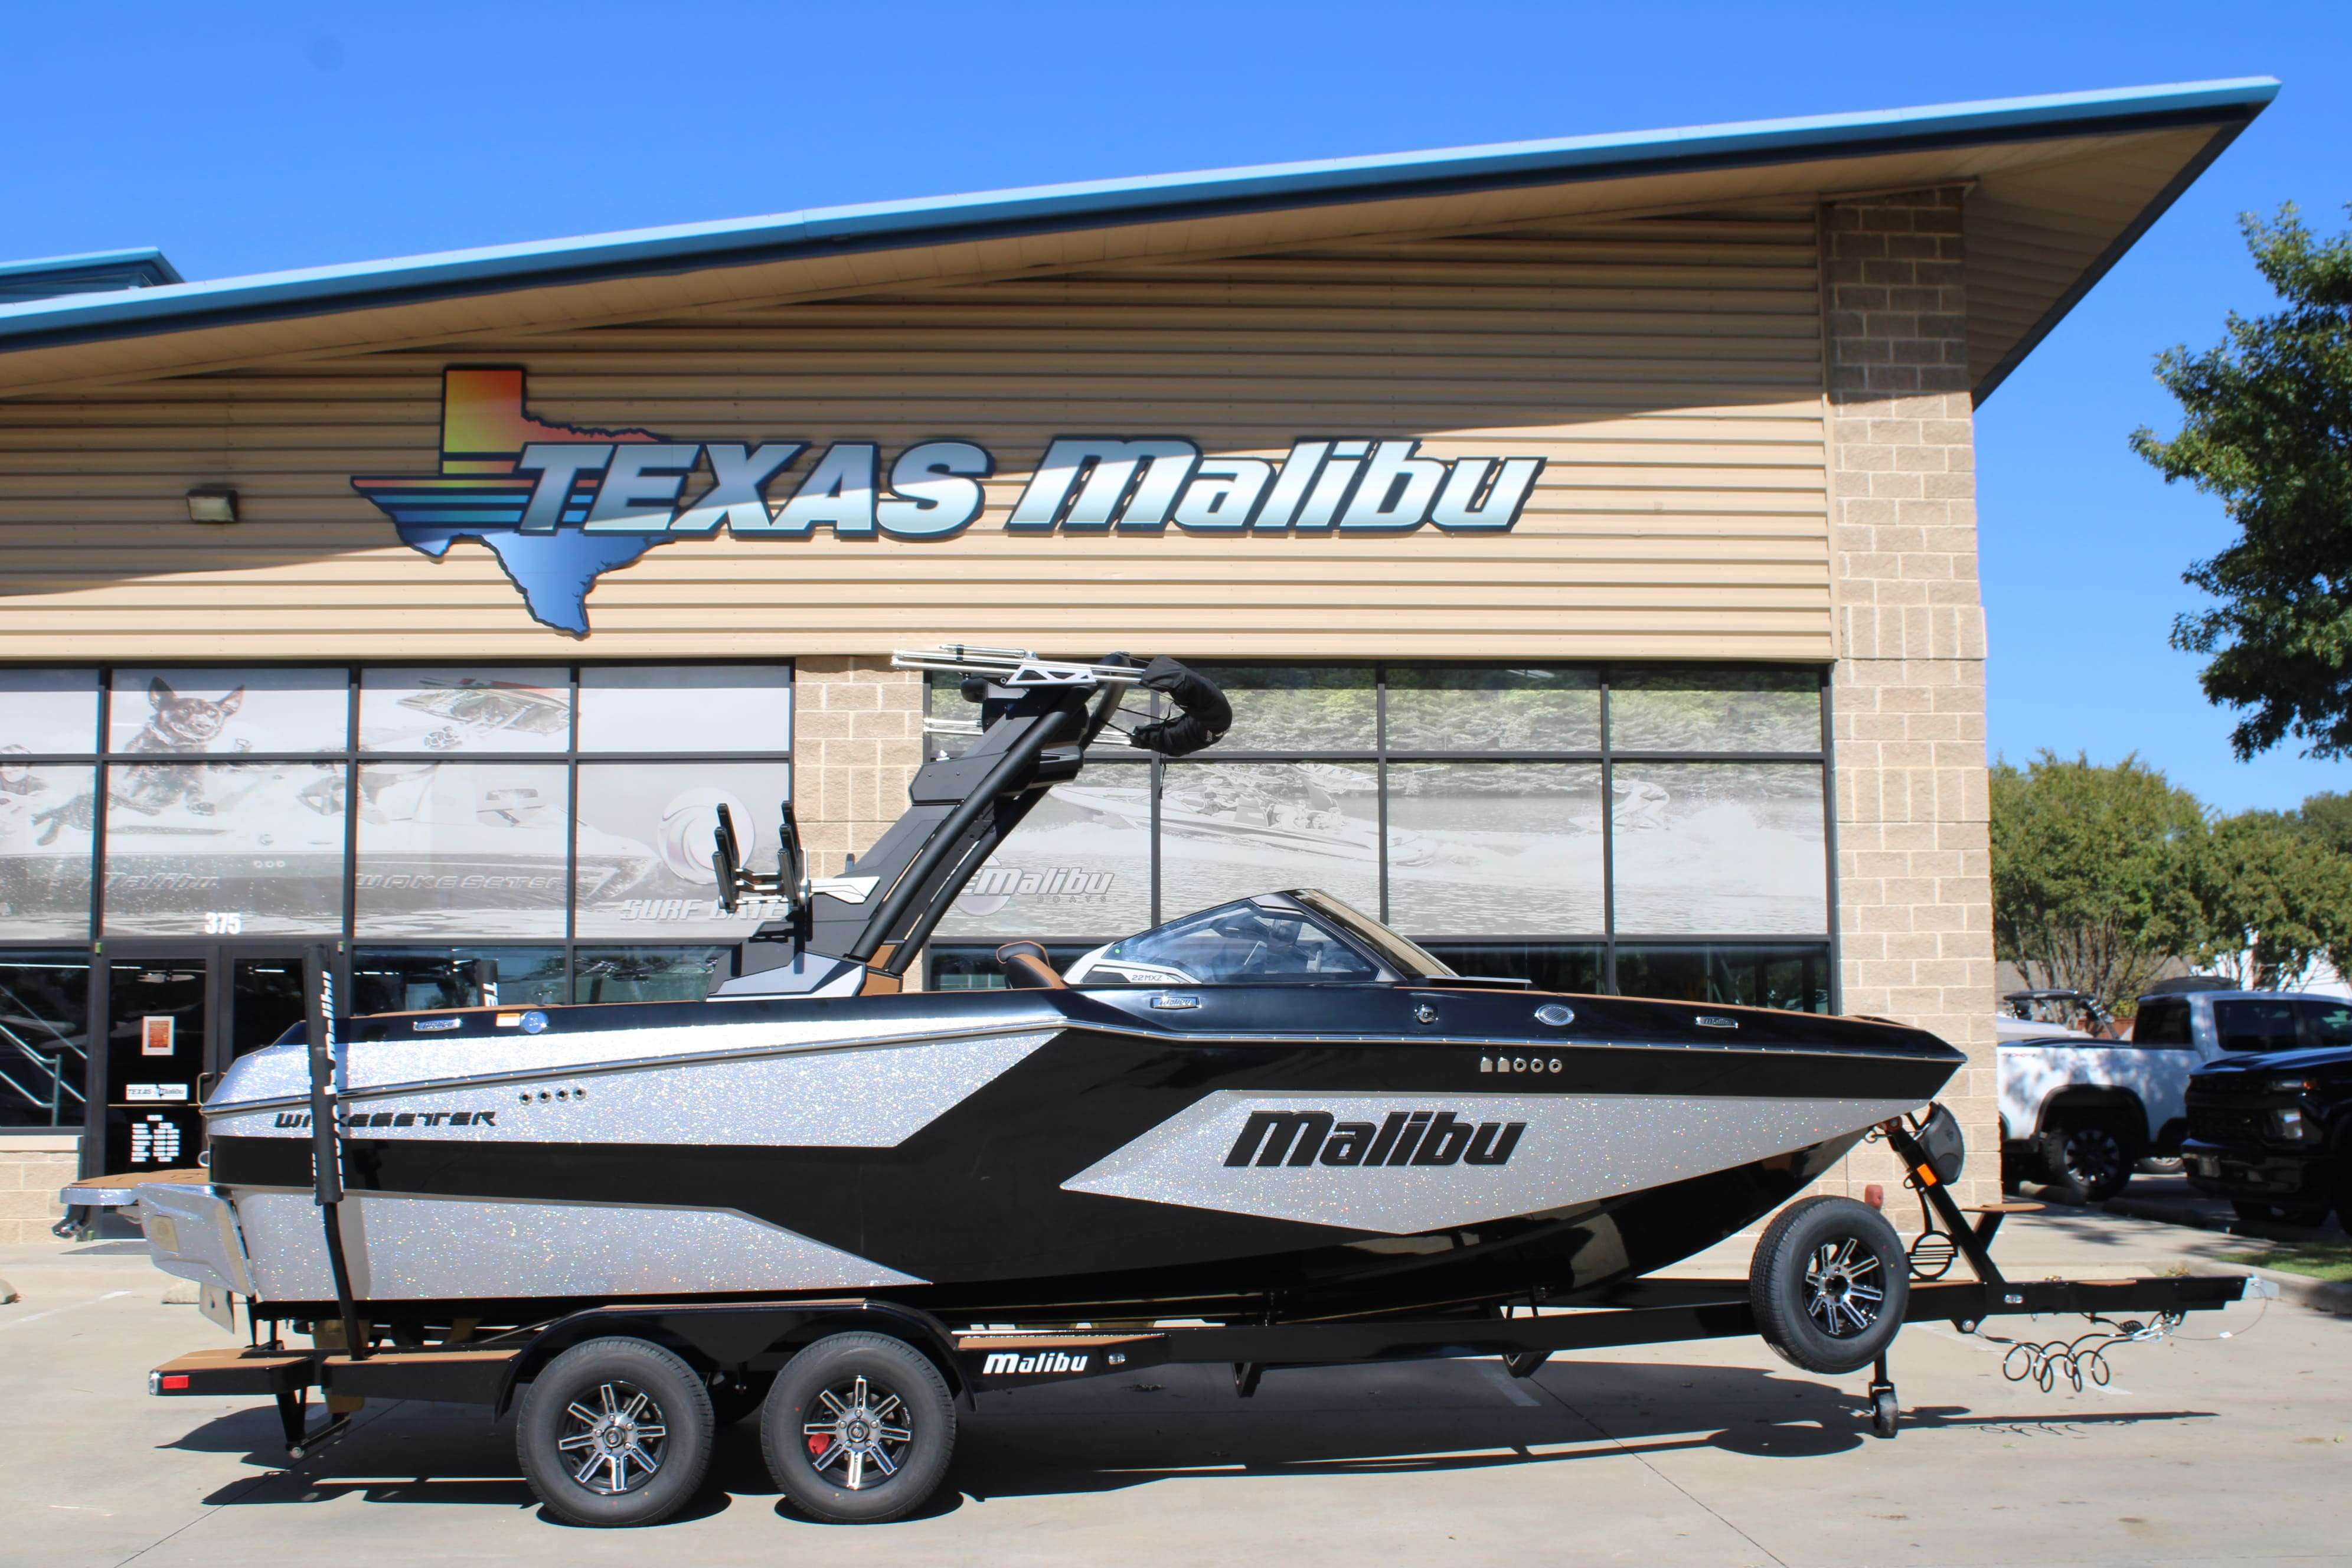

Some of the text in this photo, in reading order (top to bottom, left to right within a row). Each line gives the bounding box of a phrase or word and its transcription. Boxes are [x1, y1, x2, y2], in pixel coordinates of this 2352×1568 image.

[515, 436, 1544, 536] TEXAS Malibu
[972, 867, 1114, 894] Malibu
[619, 899, 703, 920] SURF
[204, 913, 243, 935] 375
[275, 1111, 497, 1128] WESETTER
[1224, 1110, 1528, 1167] Malibu
[982, 1352, 1088, 1374] Malibu
